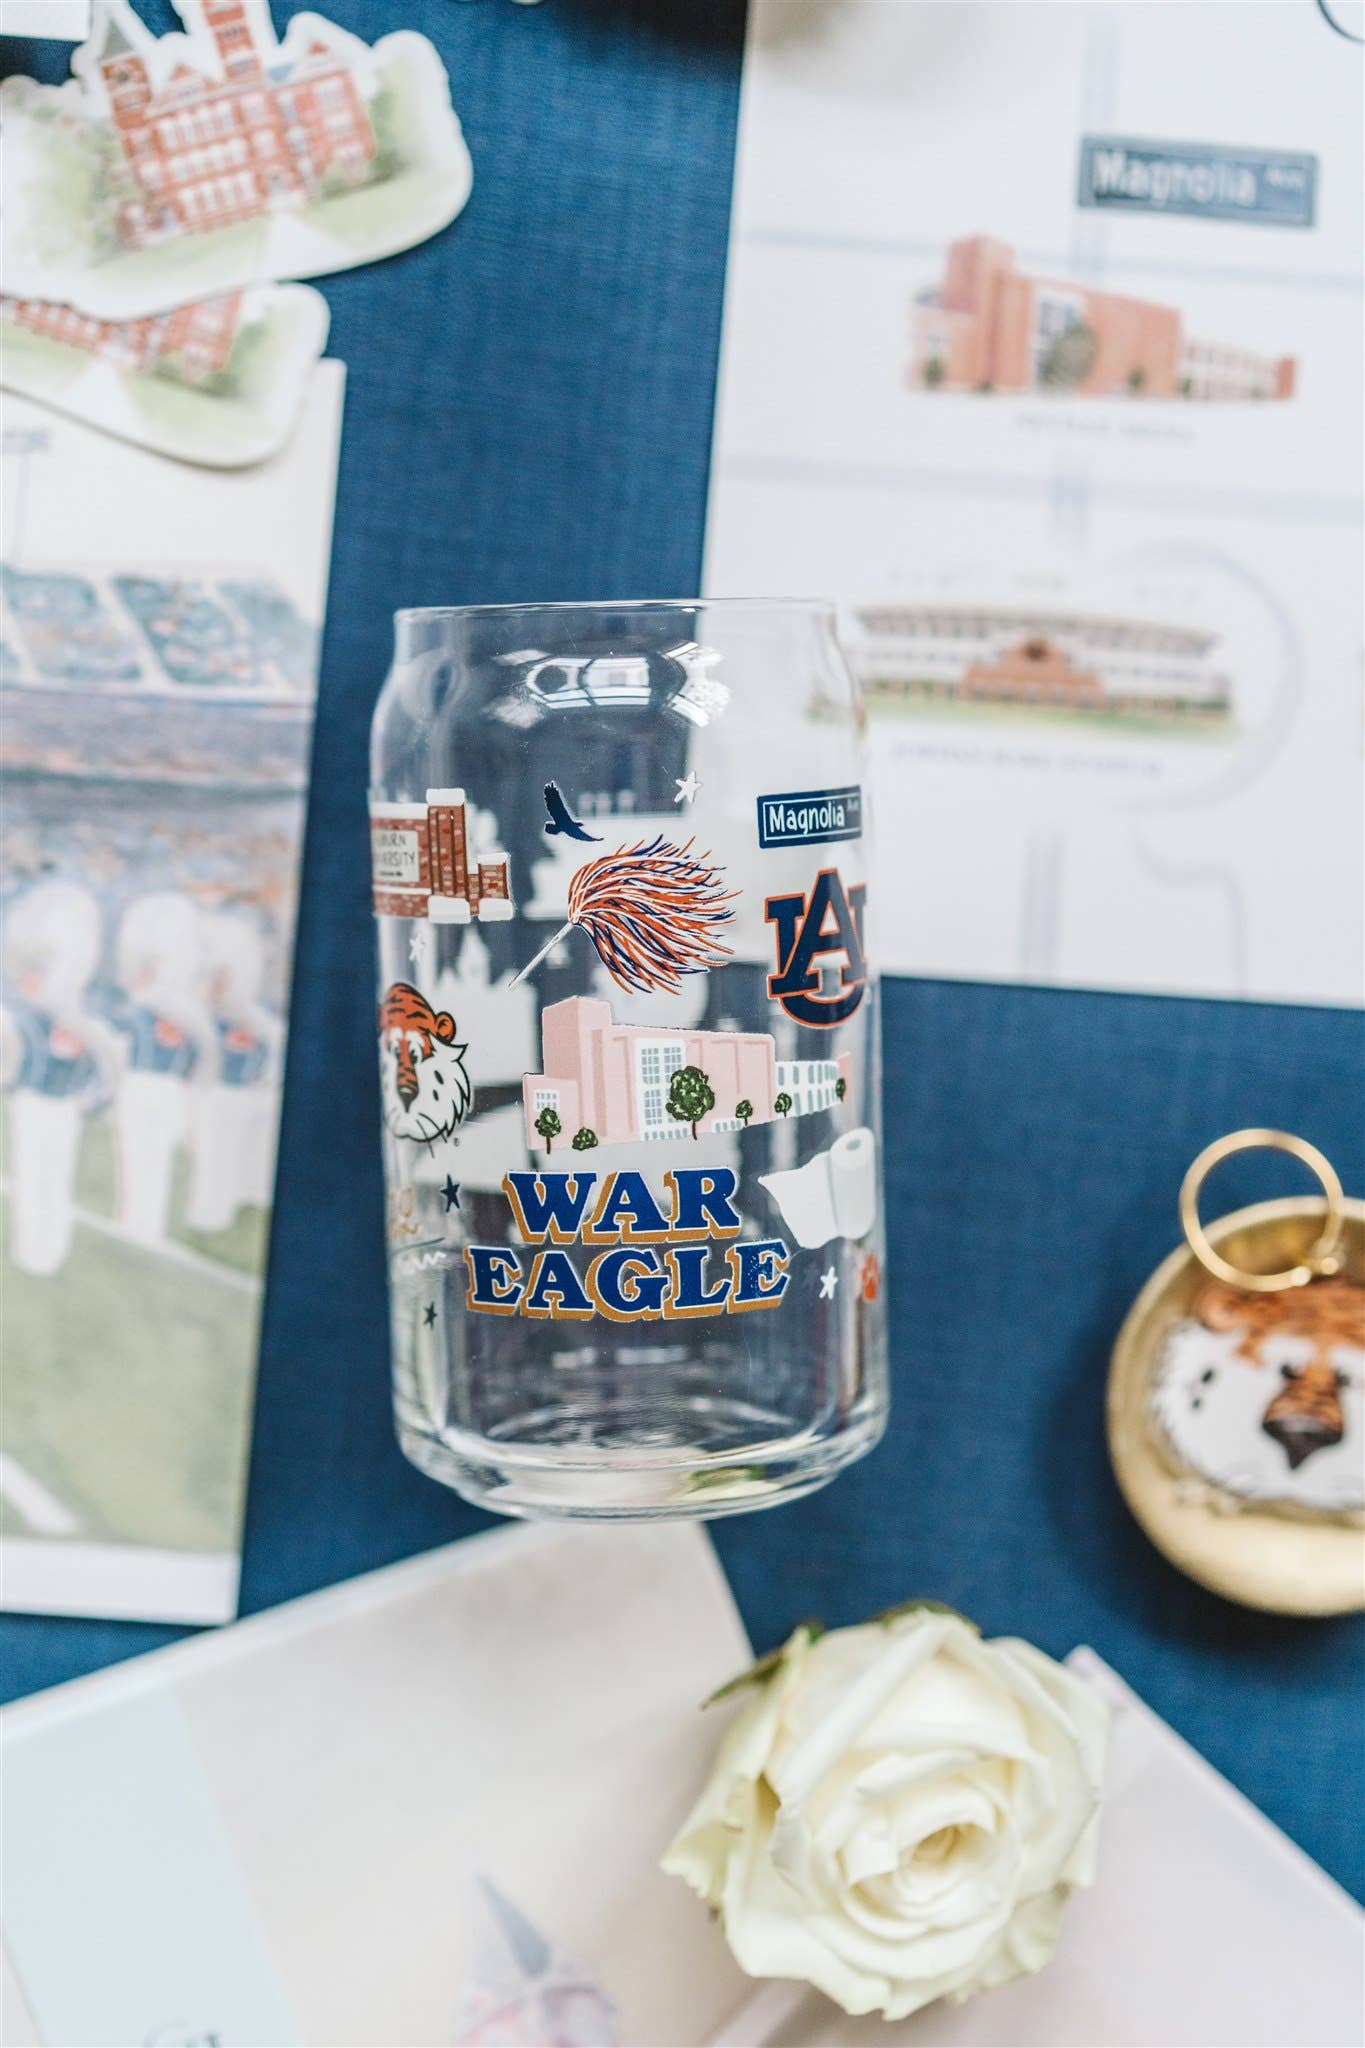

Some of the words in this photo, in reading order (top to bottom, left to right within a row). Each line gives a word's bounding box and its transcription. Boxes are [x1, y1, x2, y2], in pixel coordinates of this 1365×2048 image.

[1094, 148, 1256, 208] Magnolia
[769, 801, 845, 836] Magnolia
[501, 1167, 742, 1245] WAR
[463, 1238, 791, 1323] EAGLE
